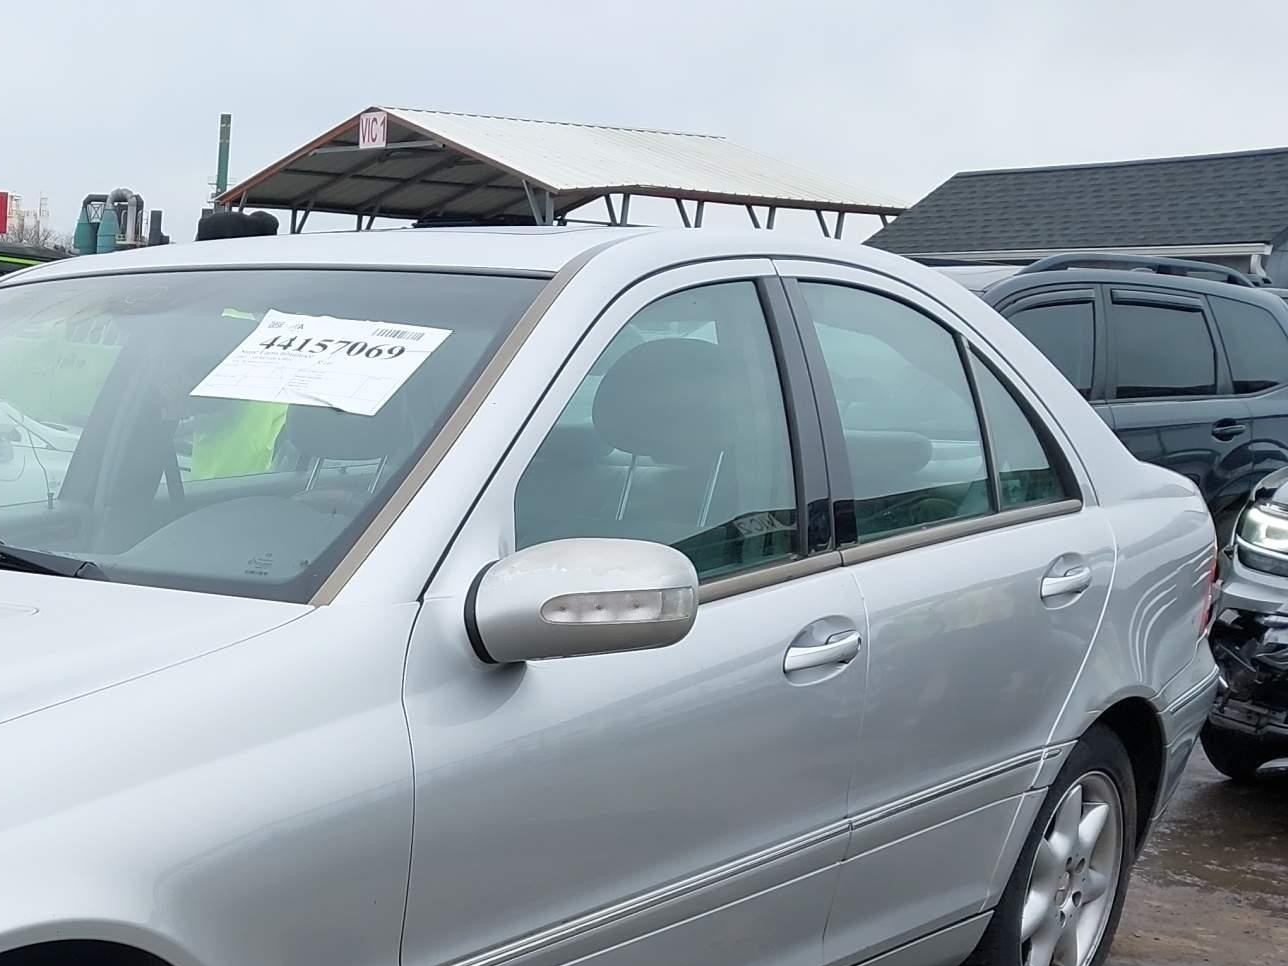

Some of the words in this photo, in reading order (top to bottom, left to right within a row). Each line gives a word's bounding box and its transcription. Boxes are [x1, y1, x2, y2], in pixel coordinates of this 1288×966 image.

[361, 117, 378, 144] VIC
[381, 115, 386, 142] 1
[259, 335, 405, 360] 44157069
